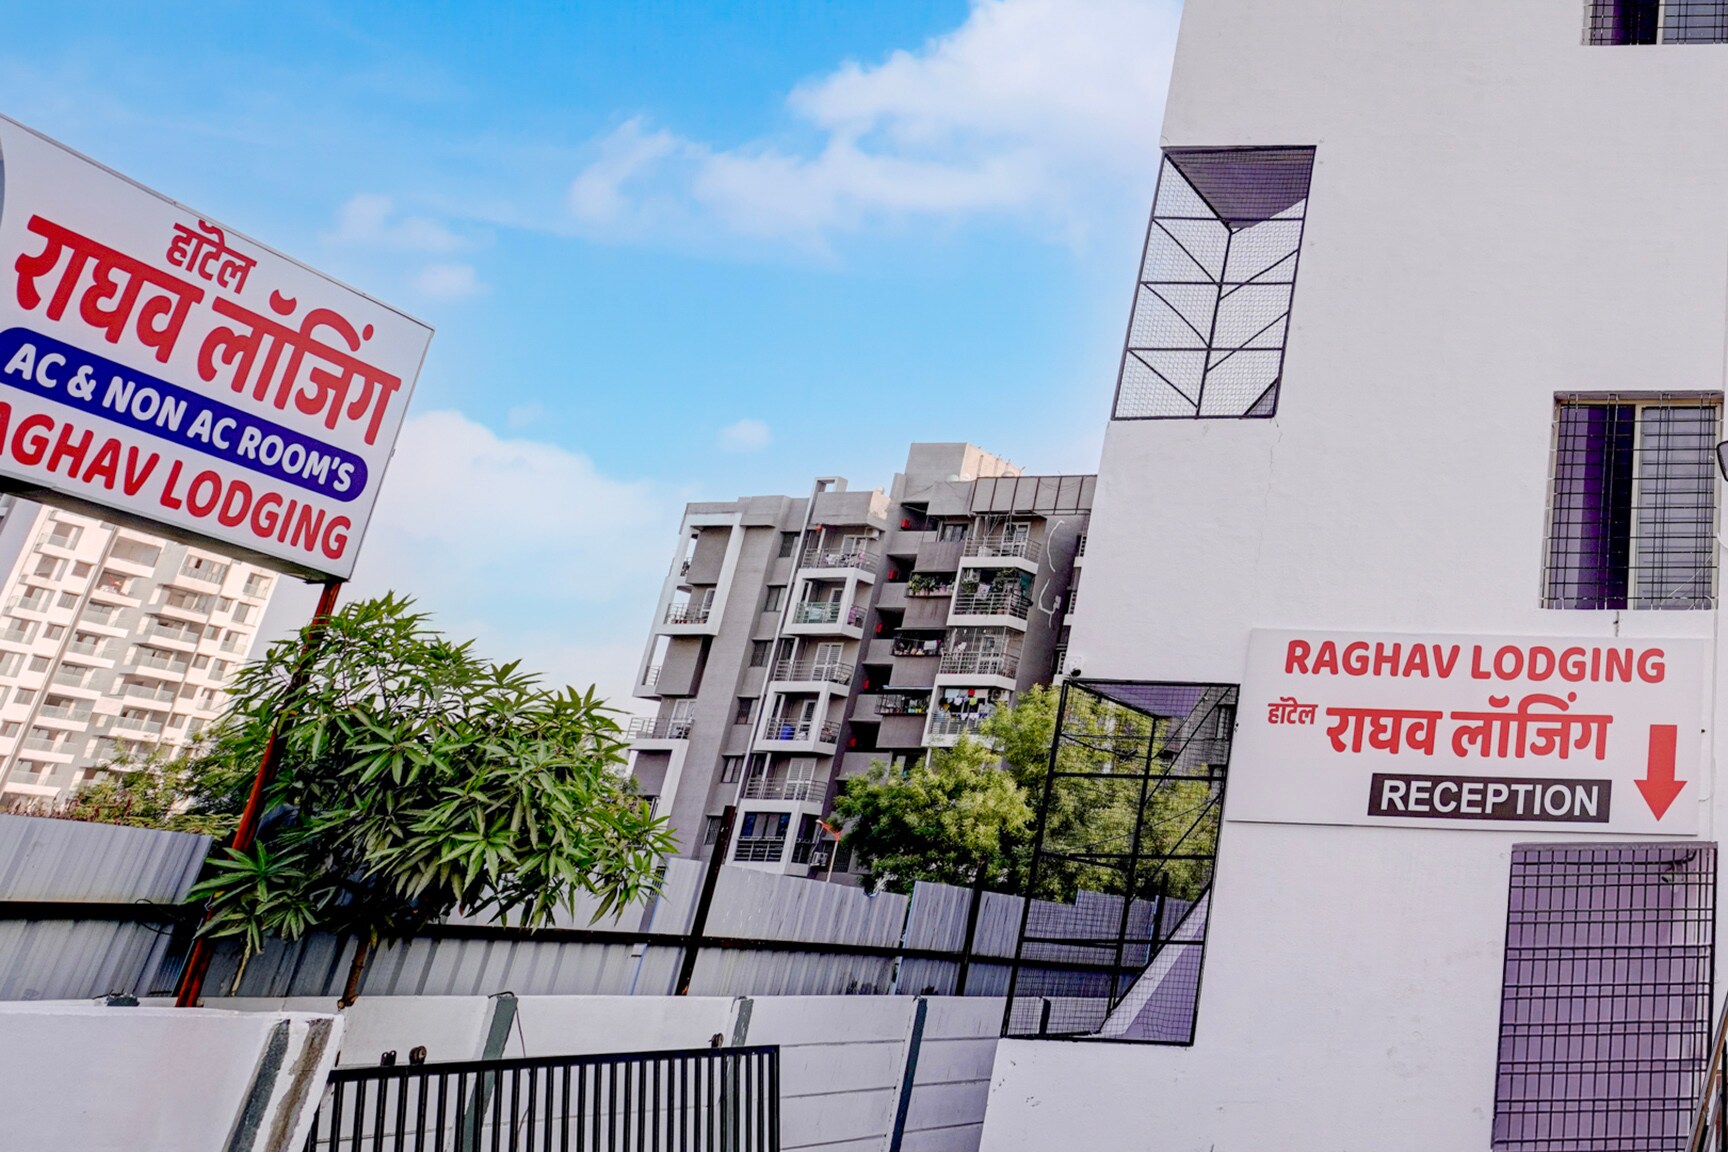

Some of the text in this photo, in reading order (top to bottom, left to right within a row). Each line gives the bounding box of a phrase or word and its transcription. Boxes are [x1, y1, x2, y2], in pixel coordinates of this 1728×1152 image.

[14, 214, 402, 446] राघव लॉजिंग
[4, 343, 355, 492] AC & NON AC ROOM'S
[160, 459, 352, 561] LODGING
[1284, 639, 1666, 684] RAGHAV LODGING
[1325, 706, 1444, 757] राघव
[1449, 691, 1614, 761] लॉजिंग
[1380, 779, 1599, 817] RECEPTION
